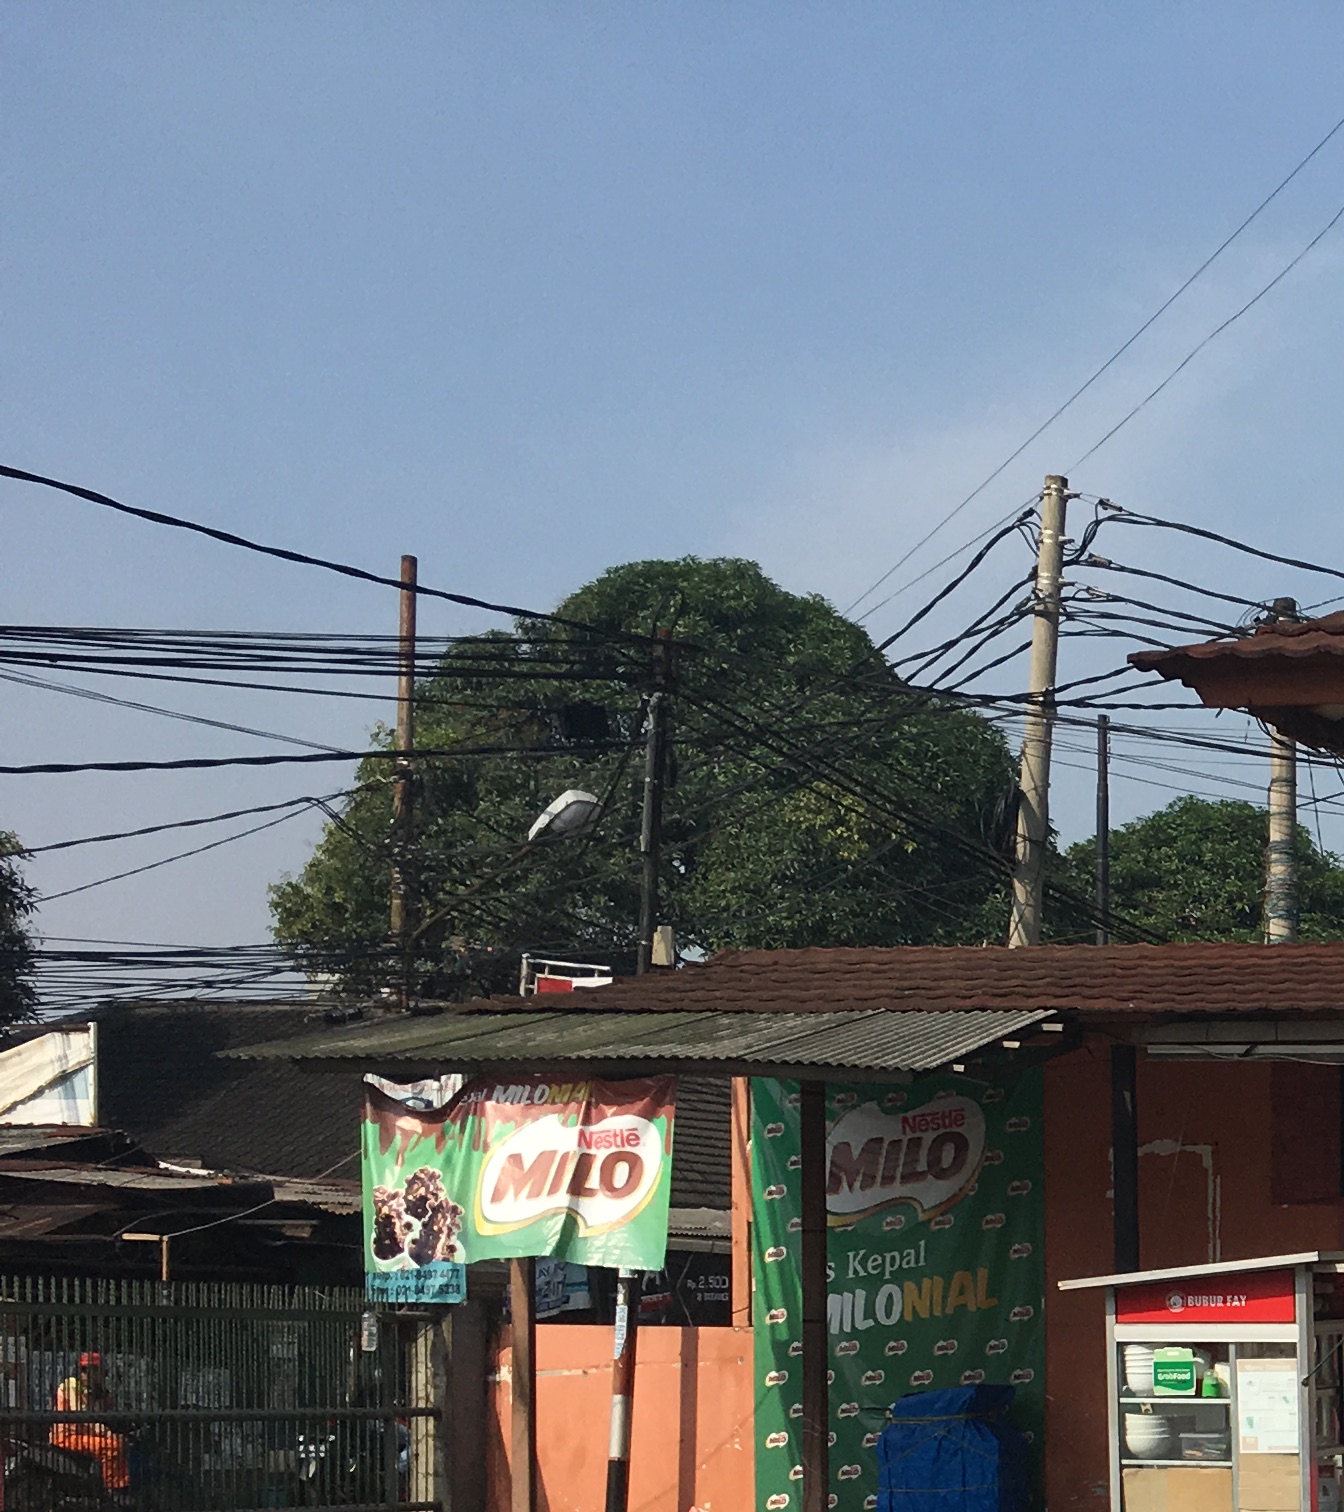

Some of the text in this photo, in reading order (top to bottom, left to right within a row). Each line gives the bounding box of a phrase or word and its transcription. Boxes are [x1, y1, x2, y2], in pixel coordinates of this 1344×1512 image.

[490, 1149, 644, 1204] MILO
[826, 1131, 970, 1196] MILO
[846, 1240, 926, 1280] Kepal
[1187, 1295, 1247, 1308] BUBUR FAY
